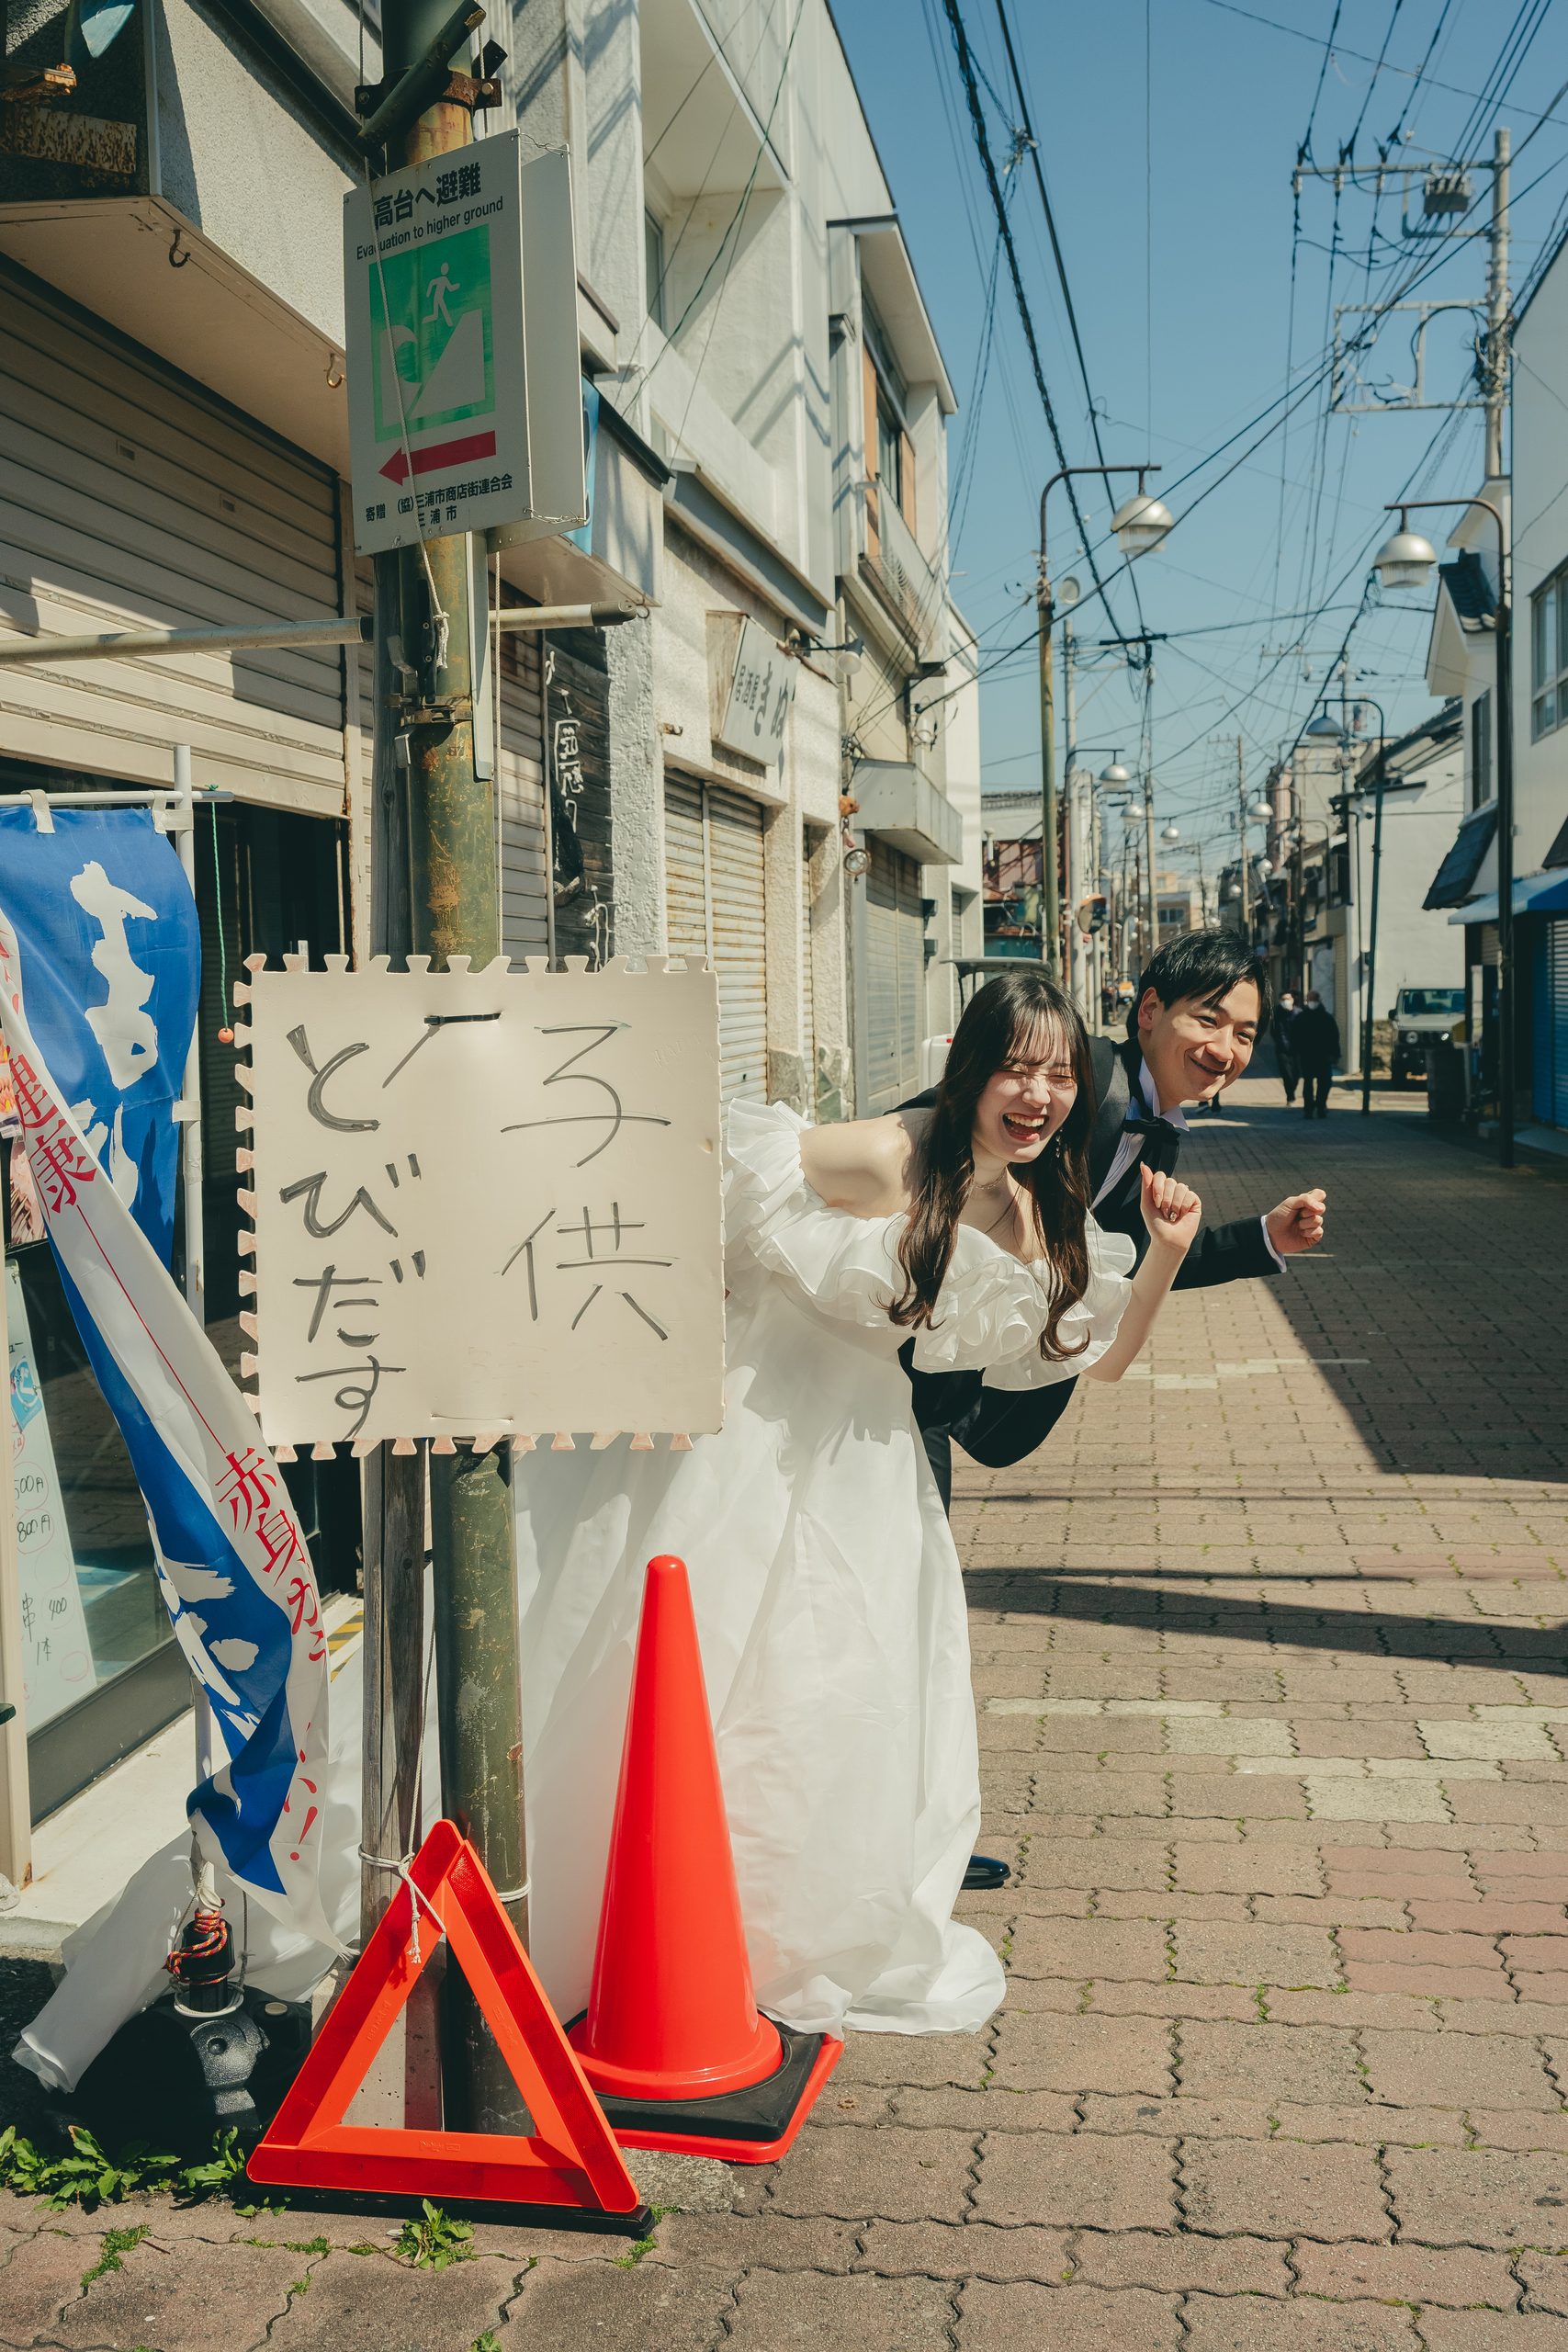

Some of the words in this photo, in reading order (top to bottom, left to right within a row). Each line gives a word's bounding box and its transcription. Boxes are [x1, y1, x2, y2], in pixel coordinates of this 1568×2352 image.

[374, 162, 481, 230] 高台へ避難
[413, 226, 424, 240] to
[426, 212, 461, 235] higher
[463, 196, 503, 224] ground
[366, 503, 386, 523] 寄贈
[736, 664, 761, 711] 居酒屋
[500, 1021, 675, 1341] 子供
[49, 1597, 67, 1621] 400
